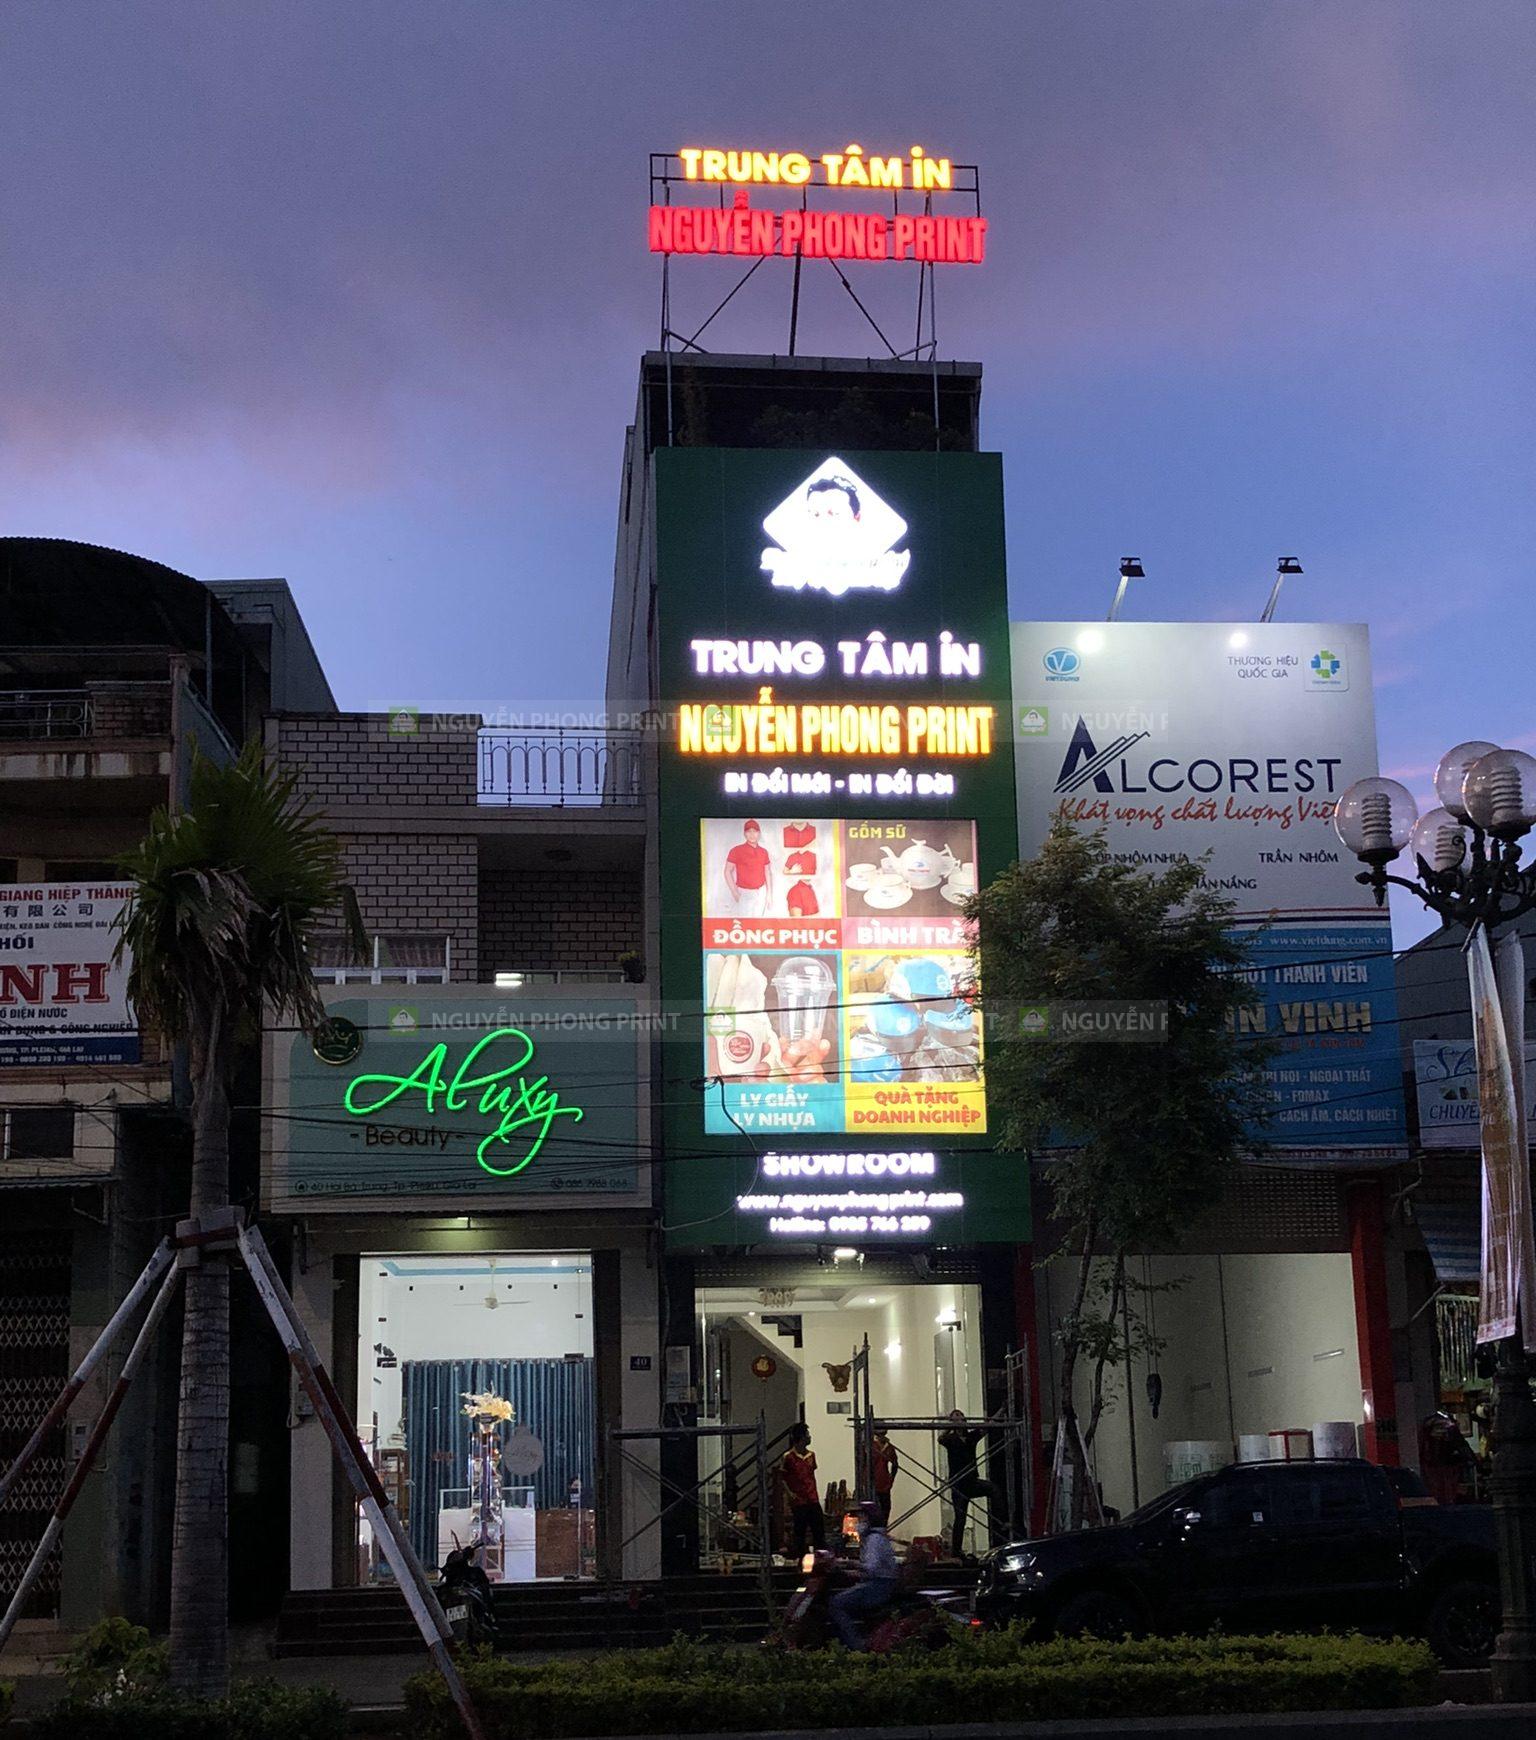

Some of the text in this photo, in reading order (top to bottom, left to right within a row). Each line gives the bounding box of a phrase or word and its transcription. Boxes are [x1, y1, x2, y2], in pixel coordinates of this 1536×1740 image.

[681, 148, 811, 184] TRUNG
[822, 144, 904, 187] TÂM
[650, 190, 986, 263] NGUYỄN PHONG PRINT
[691, 639, 825, 675] TRUNG
[838, 631, 928, 675] TÂM
[1227, 655, 1299, 667] THƯƠNG HIỆU
[1237, 666, 1289, 679] QUỐC GIA
[680, 686, 995, 754] NGUYỄN PHONG PRINT
[1053, 715, 1342, 793] ALCOREST
[1058, 797, 1109, 821] Khát
[1114, 805, 1165, 829] vọng
[1171, 797, 1218, 821] chất
[1224, 796, 1293, 829] lượng
[848, 821, 882, 839] GỐM
[1114, 850, 1152, 864] NHÔM
[1300, 849, 1339, 863] NHÔM
[3, 904, 94, 917] 有限公司
[714, 919, 838, 949] ĐỒNG PHỤC
[857, 919, 919, 945] BÌNH
[1331, 961, 1368, 983] VIÊN
[741, 1085, 809, 1107] LY GIẤY
[874, 1086, 959, 1108] QUÀ TẶNG
[759, 1112, 815, 1130] NHỰA
[854, 1105, 981, 1128] DOANH NGHIỆP
[365, 1125, 450, 1151] Beauty
[763, 1152, 935, 1175] SHOWROOM
